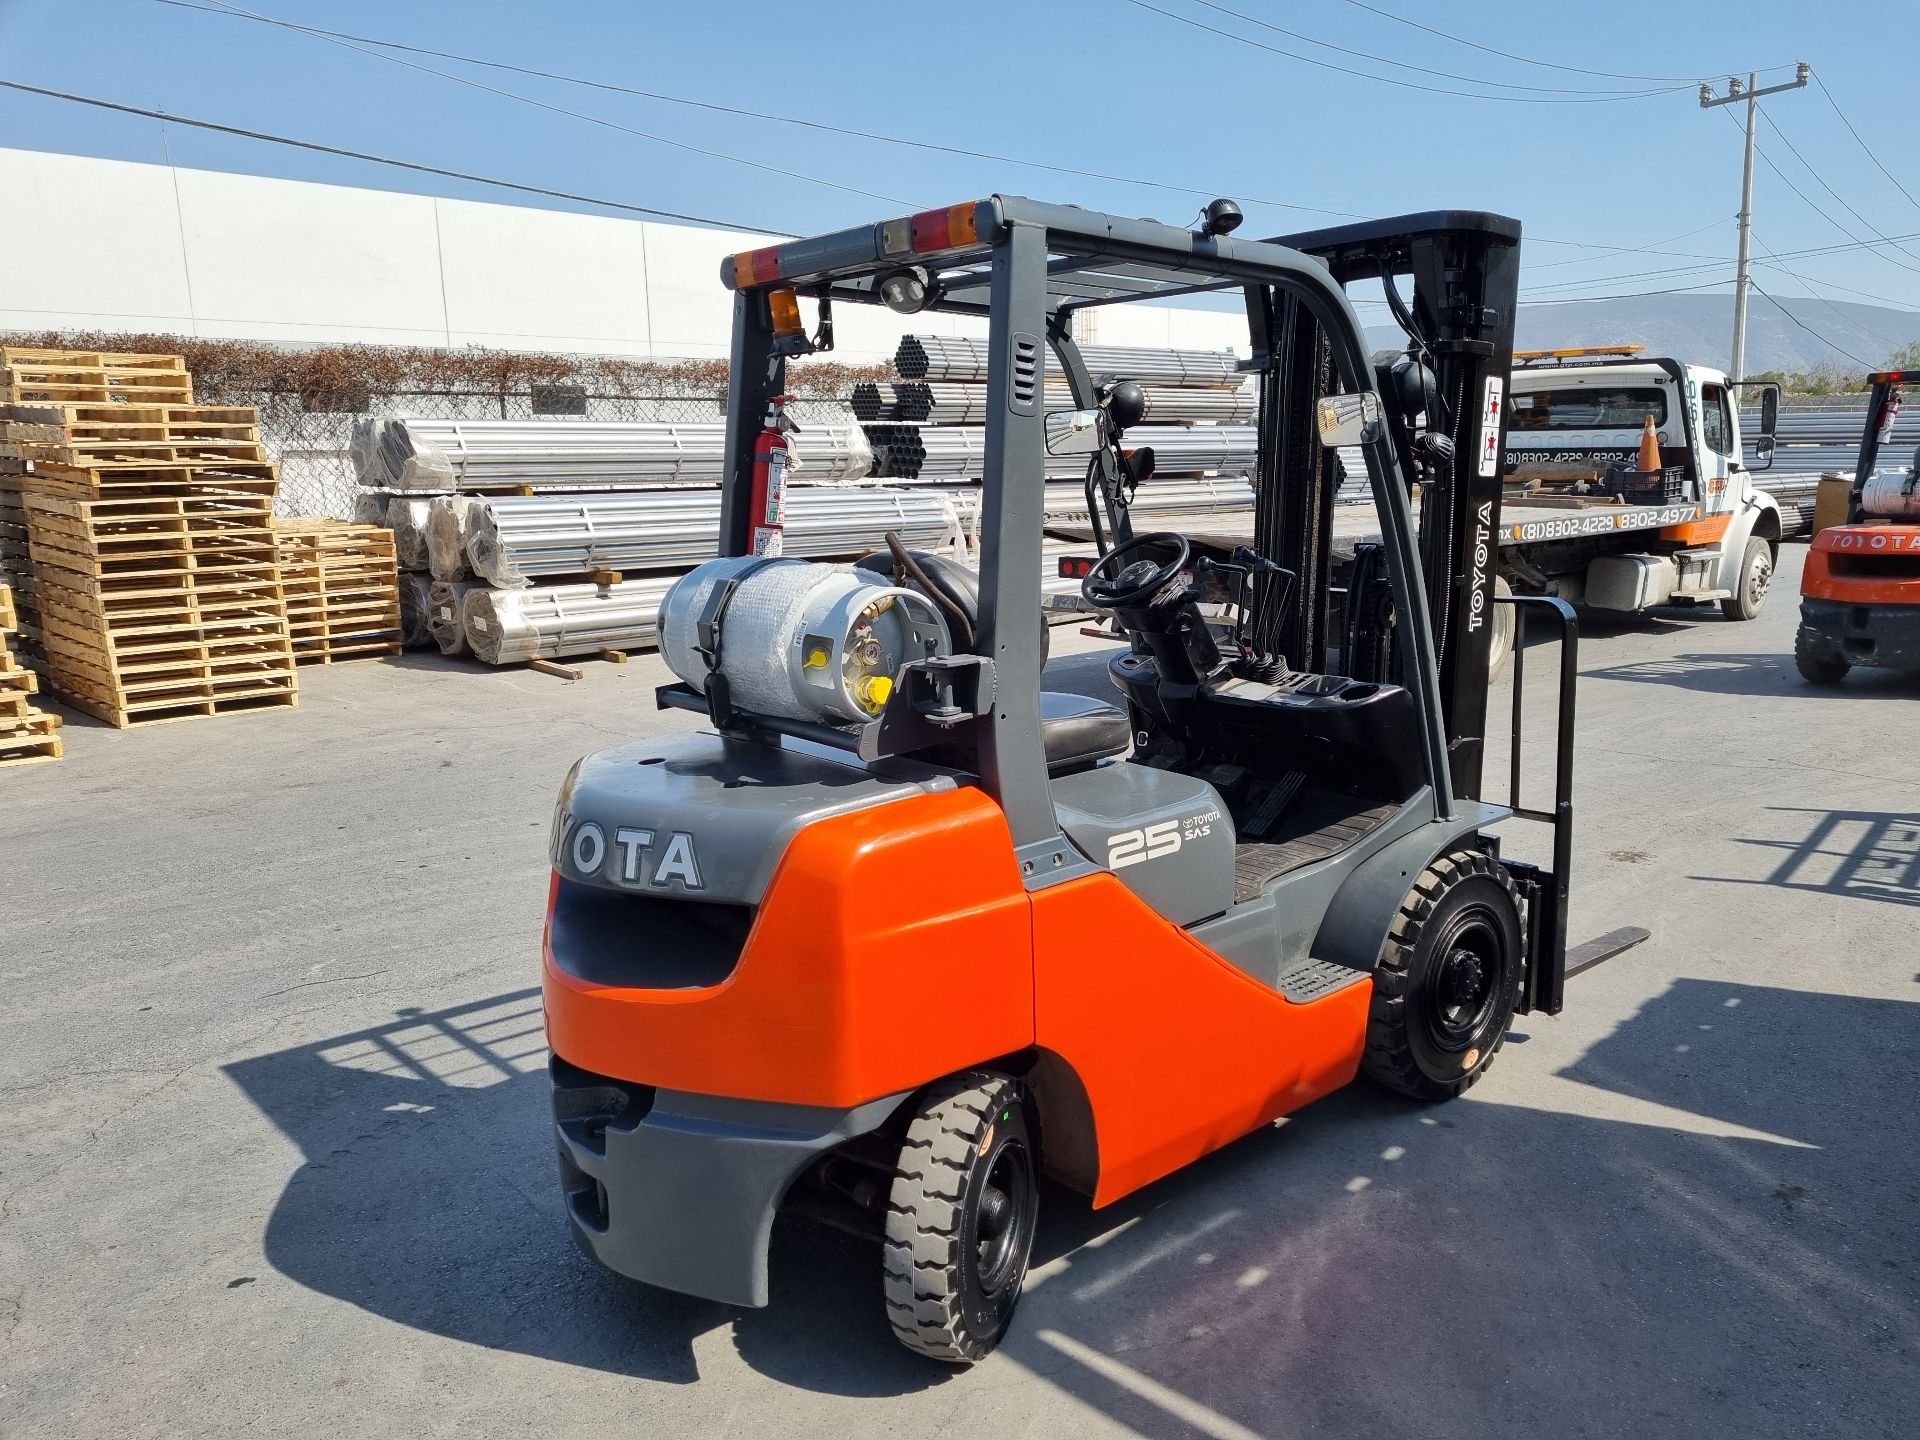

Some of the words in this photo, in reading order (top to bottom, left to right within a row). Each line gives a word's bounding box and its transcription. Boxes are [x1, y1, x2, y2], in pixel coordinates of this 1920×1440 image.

[1521, 515, 1614, 541] (81)8302-4229
[1620, 507, 1697, 529] 8302-4977
[1468, 501, 1493, 632] TOYOTA
[1184, 825, 1211, 841] SAS
[1193, 811, 1221, 826] TOYOTA
[551, 808, 702, 889] YOTA
[1107, 820, 1181, 870] 25
